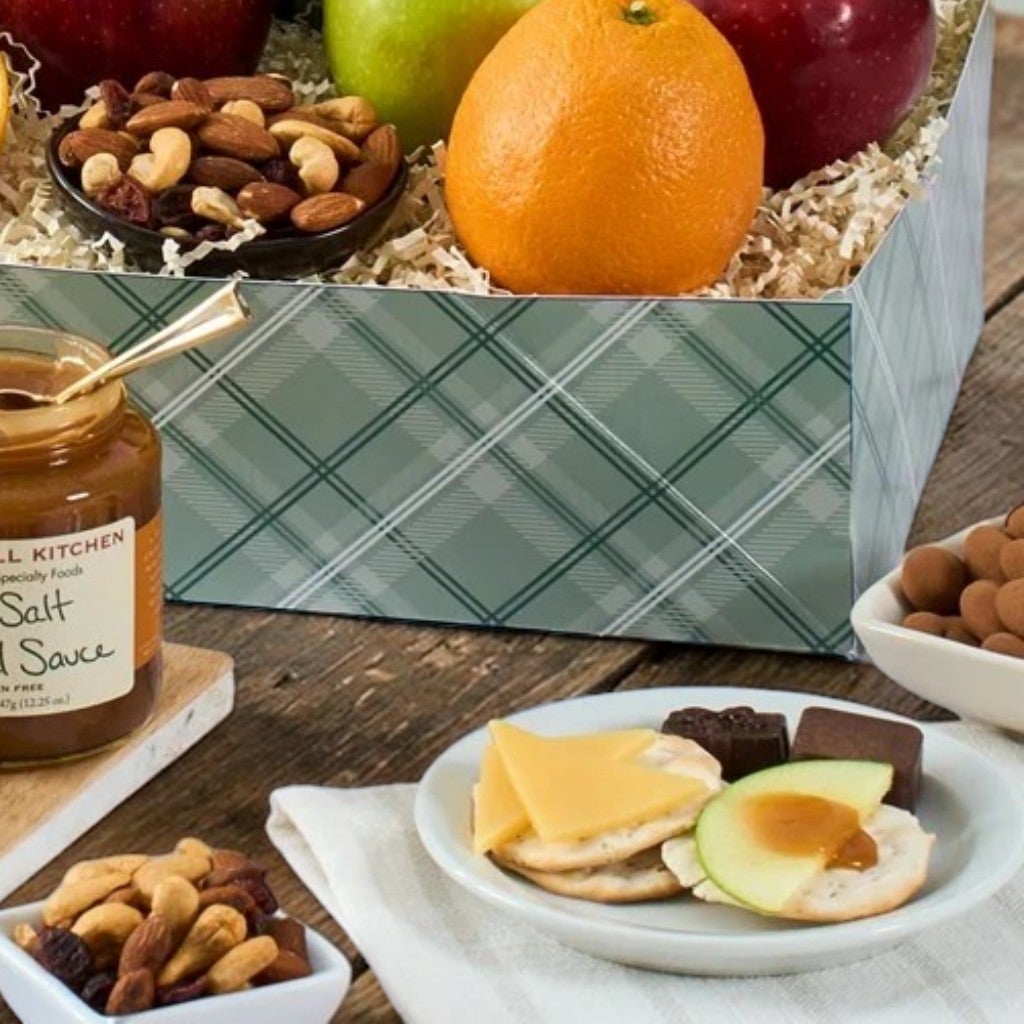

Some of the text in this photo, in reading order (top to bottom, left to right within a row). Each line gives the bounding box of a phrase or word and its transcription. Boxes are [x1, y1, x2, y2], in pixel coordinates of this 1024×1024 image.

[33, 529, 125, 562] KITCHEN
[51, 565, 84, 579] Foods
[0, 588, 74, 627] Salt
[19, 638, 116, 676] Sauce
[14, 683, 44, 692] FREE
